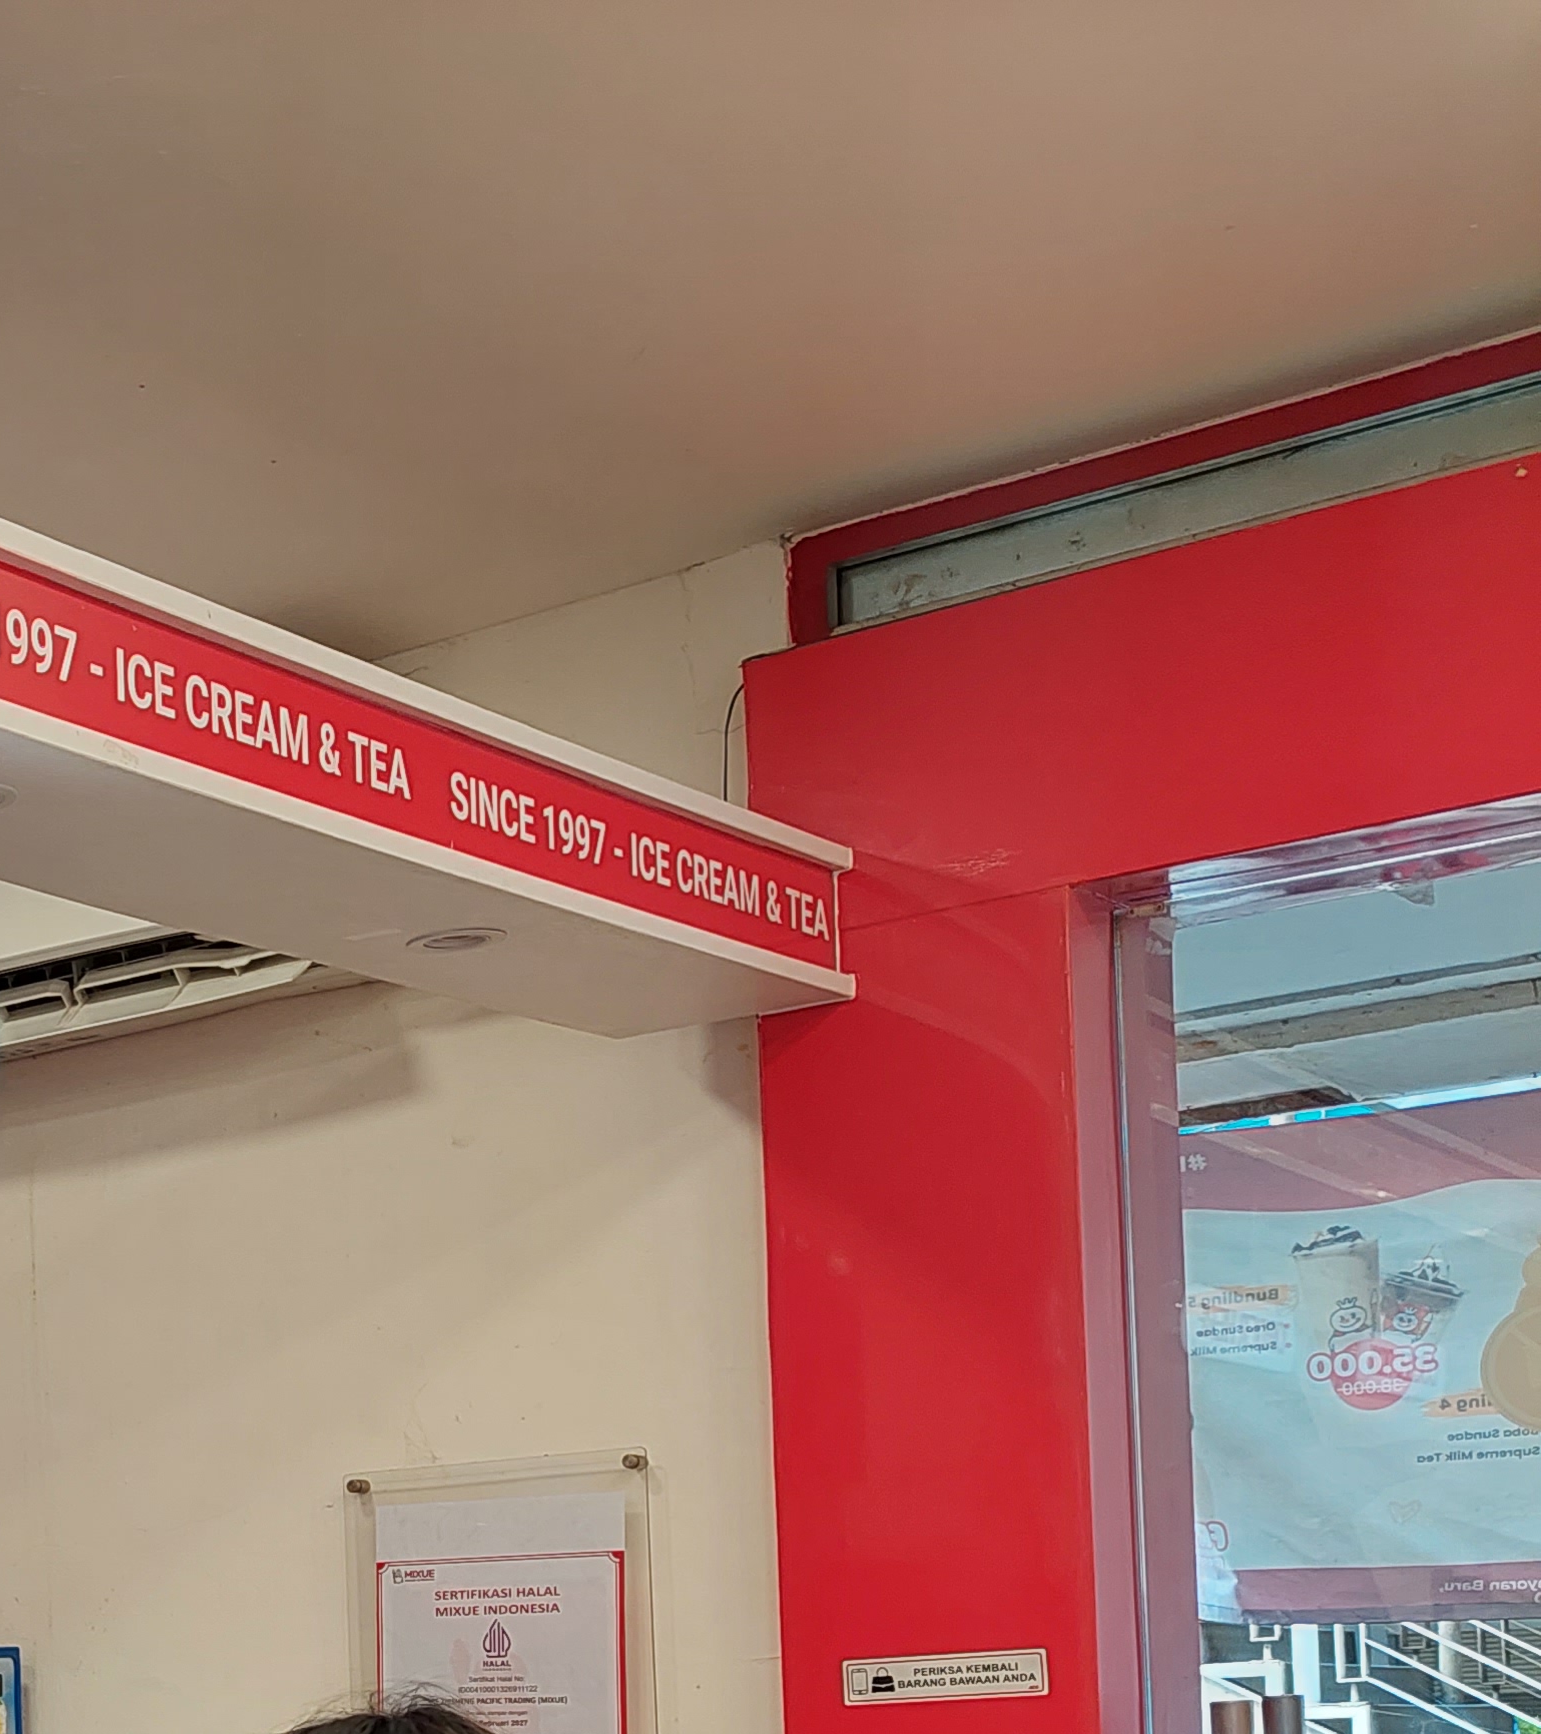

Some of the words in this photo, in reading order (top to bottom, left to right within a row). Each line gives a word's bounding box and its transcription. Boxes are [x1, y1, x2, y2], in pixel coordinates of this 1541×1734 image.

[112, 648, 176, 718] ICE
[184, 674, 310, 766] CREAM
[318, 730, 343, 778] &
[349, 737, 411, 802] TEA
[448, 771, 537, 844] SINCE
[541, 810, 605, 864] 1997
[629, 835, 671, 884] ICE
[674, 845, 760, 915] CREAM
[764, 883, 783, 917] &
[786, 888, 831, 941] TEA
[404, 1569, 435, 1580] MIXUE
[434, 1587, 512, 1601] SERTIFIKASI
[516, 1586, 561, 1598] HALAL
[435, 1605, 480, 1617] MIXUE
[484, 1603, 561, 1615] INDONESIA
[913, 1665, 963, 1676] PERIKSA
[966, 1662, 1018, 1674] KEMBALI
[898, 1678, 946, 1689] BARANG
[950, 1675, 999, 1686] BAWAAN
[1002, 1672, 1037, 1683] ANDA
